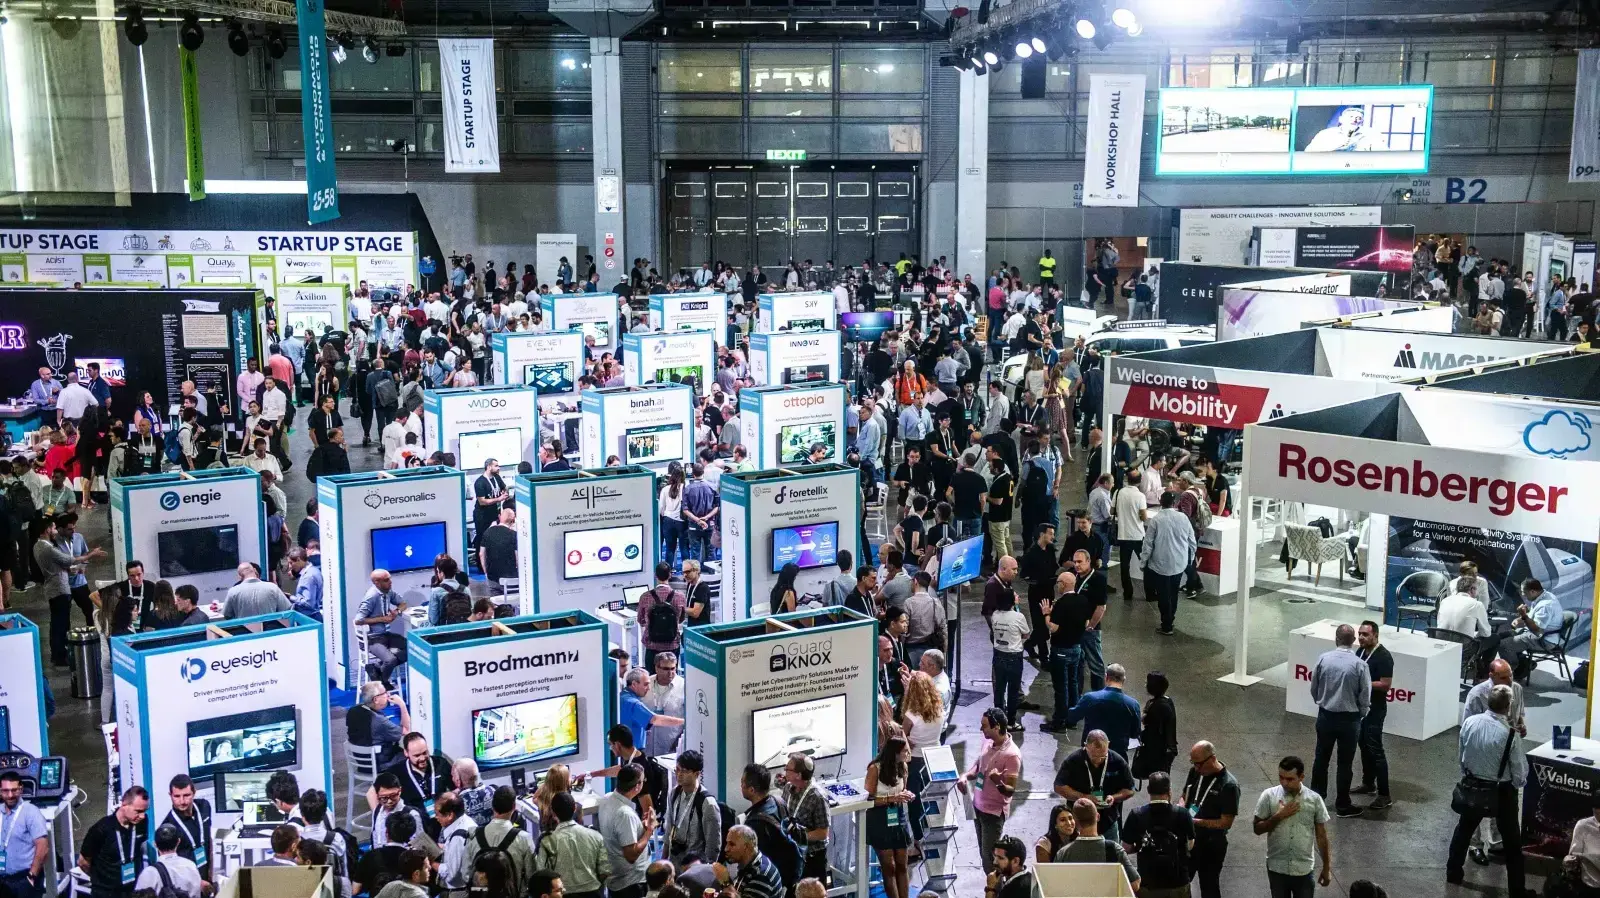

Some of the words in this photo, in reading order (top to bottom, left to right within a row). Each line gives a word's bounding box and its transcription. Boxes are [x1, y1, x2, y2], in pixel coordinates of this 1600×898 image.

[461, 59, 472, 96] STAGE
[310, 35, 324, 163] AUTONOMOUS
[314, 36, 325, 145] CONNECTED
[1110, 90, 1121, 119] HALL
[463, 99, 475, 149] STARTUP
[776, 149, 805, 160] EXIT
[1106, 122, 1119, 190] WORKSHOP
[1446, 178, 1488, 203] B2
[39, 234, 99, 249] STAGE
[258, 236, 339, 251] STARTUP
[344, 236, 403, 251] STAGE
[295, 290, 327, 301] Axilion
[240, 344, 248, 370] MICH
[1420, 352, 1506, 370] MAGN
[1116, 366, 1186, 388] Welcome
[1191, 378, 1208, 390] to
[1361, 371, 1390, 380] Partnering
[784, 395, 824, 408] ottopia
[1150, 391, 1238, 424] Mobility
[1278, 443, 1568, 516] Rosenberger
[183, 489, 221, 505] engie
[383, 492, 436, 505] Personalics
[572, 488, 585, 497] AC
[596, 486, 608, 495] DC
[789, 485, 828, 498] foretellix
[170, 517, 199, 525] maintenance
[1413, 519, 1455, 533] Automotive
[1457, 526, 1504, 540] Connectivity
[1506, 531, 1540, 543] Systems
[1413, 529, 1422, 537] for
[1431, 532, 1457, 544] Variety
[1468, 537, 1515, 551] Applications
[788, 636, 832, 656] Guard
[211, 650, 278, 673] eyesight
[787, 651, 832, 671] KNOX
[193, 690, 213, 698] Driver
[213, 684, 249, 695] monitoring
[249, 679, 269, 688] driven
[269, 678, 278, 686] by
[483, 685, 504, 693] fastest
[505, 679, 537, 690] perception
[538, 676, 564, 685] software
[741, 681, 760, 690] Fighter
[770, 674, 808, 685] Cybersecurity
[808, 669, 833, 678] Solutions
[751, 685, 783, 695] Automotive
[784, 681, 808, 691] Industry:
[809, 675, 843, 686] Foundational
[844, 673, 859, 681] Layer
[207, 693, 238, 704] computer
[239, 689, 257, 697] vision
[496, 689, 528, 698] automated
[529, 684, 550, 693] driving
[764, 692, 783, 700] Added
[783, 687, 818, 698] Connectivity
[823, 682, 845, 691] Services
[1547, 770, 1591, 790] Valens
